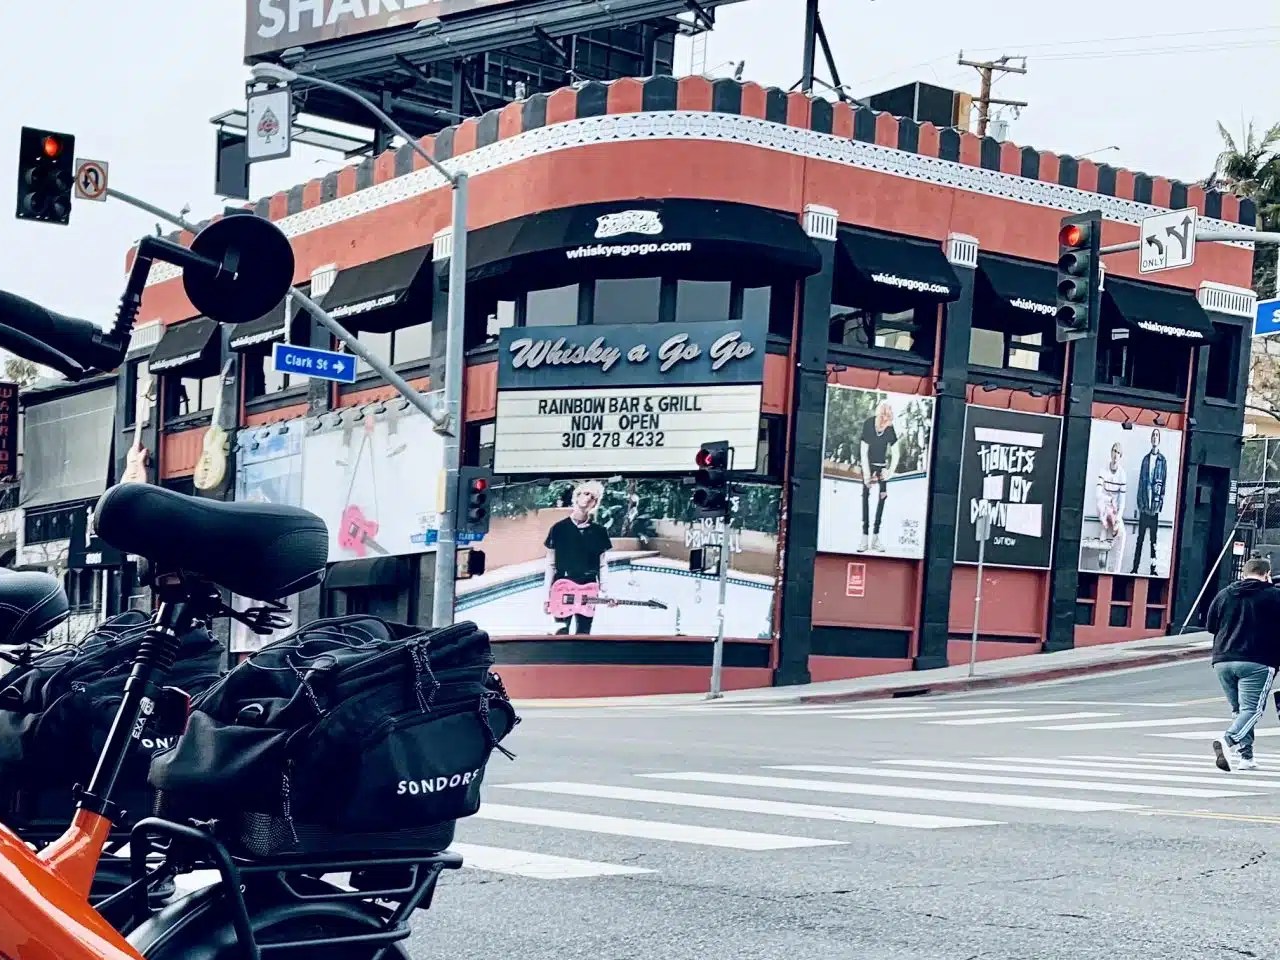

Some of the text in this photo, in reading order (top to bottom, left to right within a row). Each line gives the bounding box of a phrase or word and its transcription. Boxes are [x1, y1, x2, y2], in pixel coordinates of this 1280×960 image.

[566, 242, 691, 259] whiskyagogo.com
[1142, 255, 1165, 269] ONLY
[871, 273, 950, 294] whiskyagogo.com
[1010, 299, 1057, 317] whiskyagog
[1138, 321, 1204, 339] whiskyagogo.com
[510, 330, 755, 372] Whisky a Go Go
[285, 354, 328, 370] Clark St
[538, 395, 702, 415] RAINBOW BAR & GRILL
[571, 414, 659, 431] NOW OPEN
[562, 432, 665, 448] 310 278 4232
[397, 768, 480, 795] SONDORS
